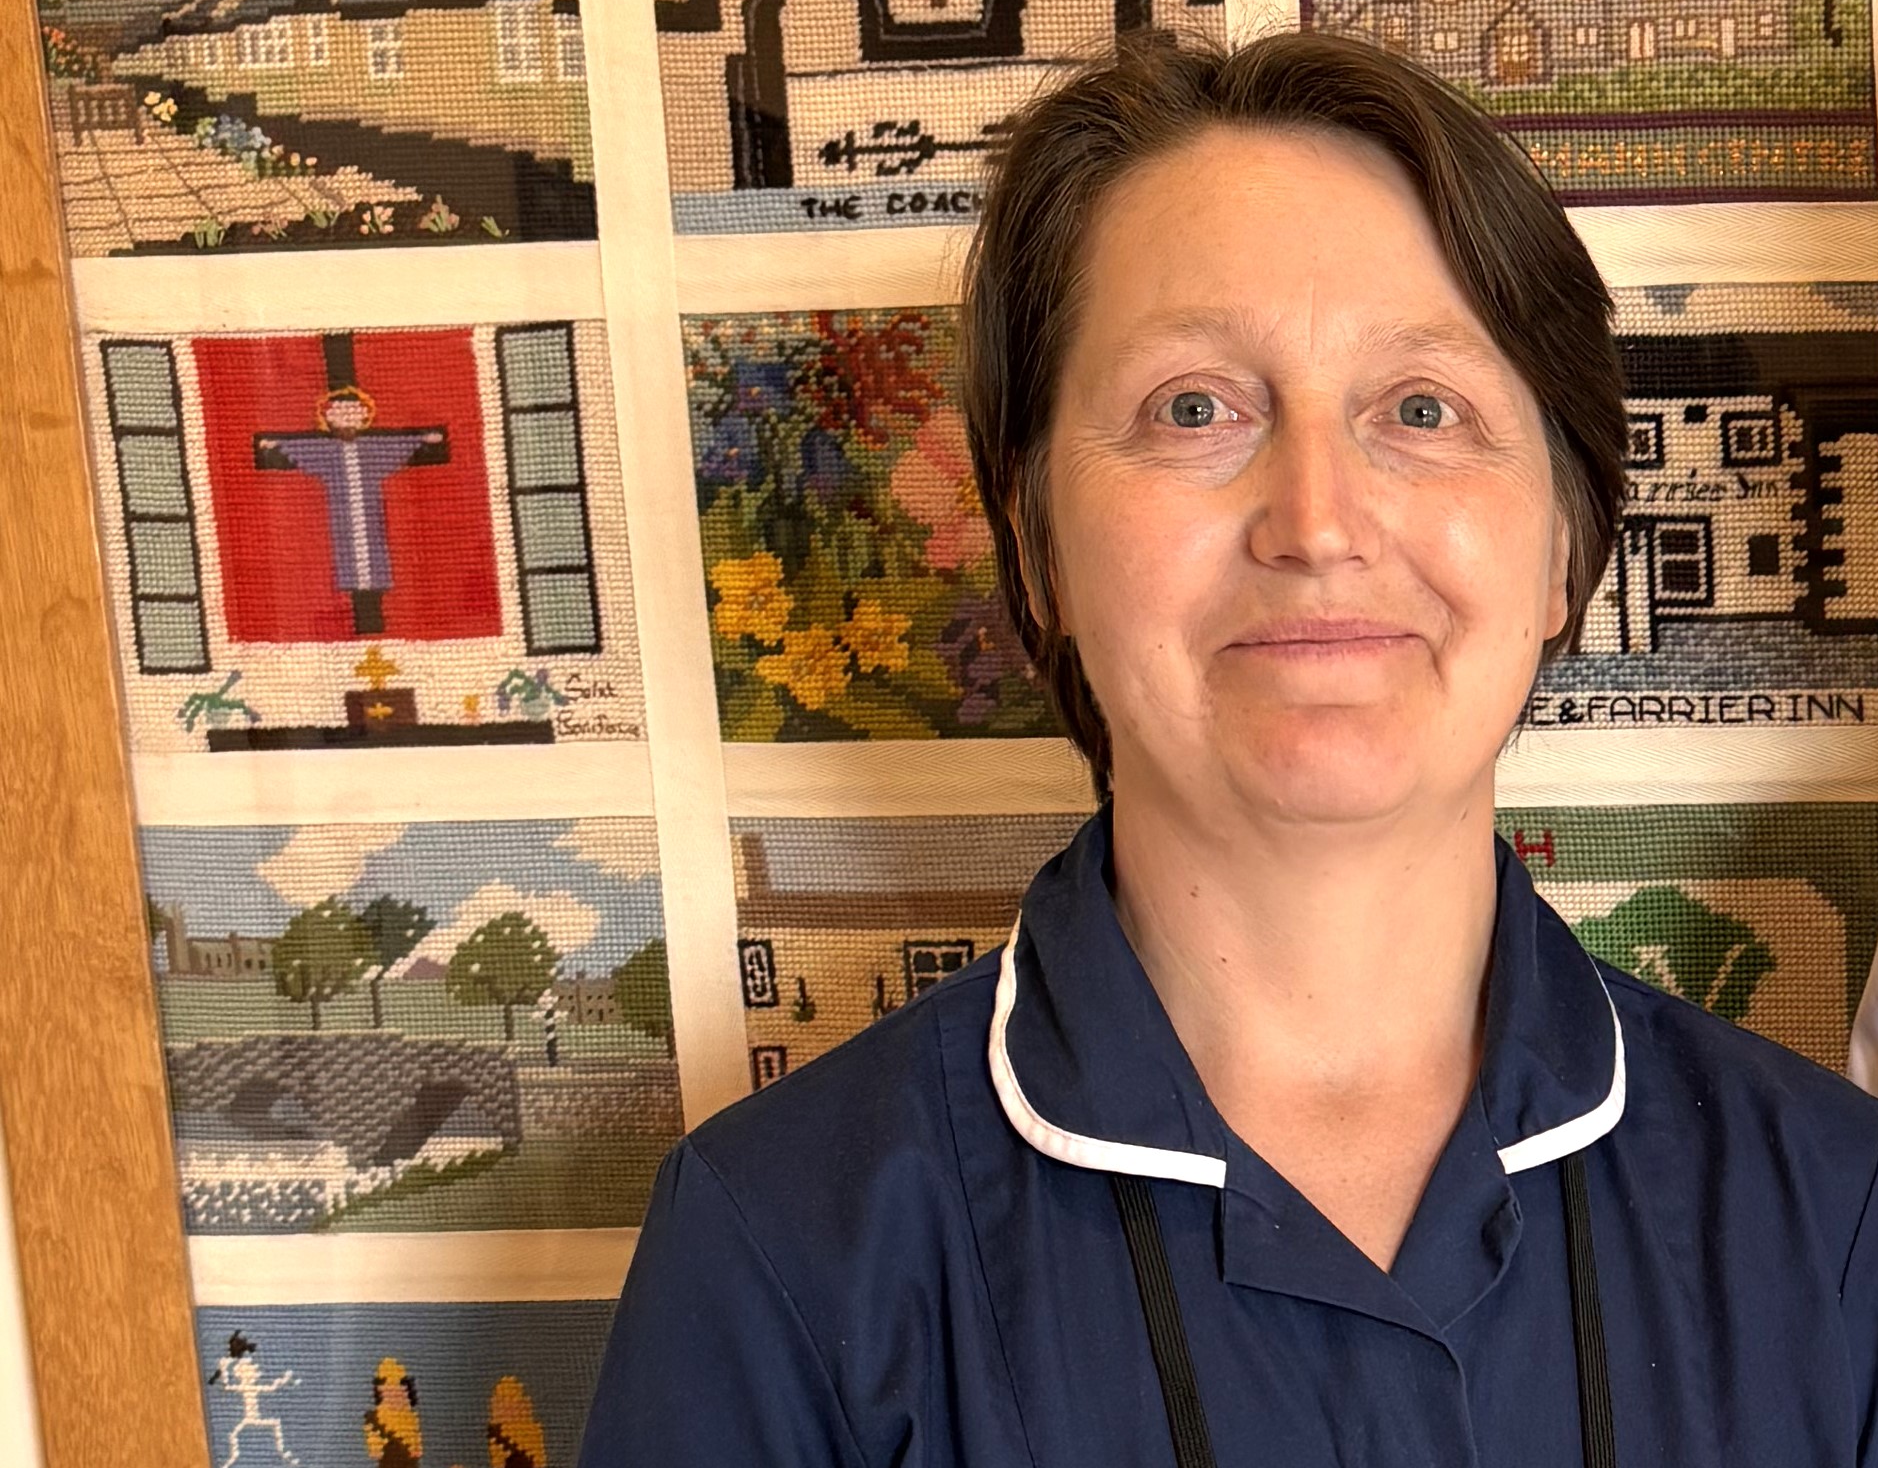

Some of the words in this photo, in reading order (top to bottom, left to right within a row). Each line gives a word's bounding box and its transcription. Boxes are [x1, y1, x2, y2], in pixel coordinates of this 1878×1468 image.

[801, 194, 862, 220] THE
[1587, 694, 1776, 723] FARRIER
[1780, 693, 1866, 722] INN
